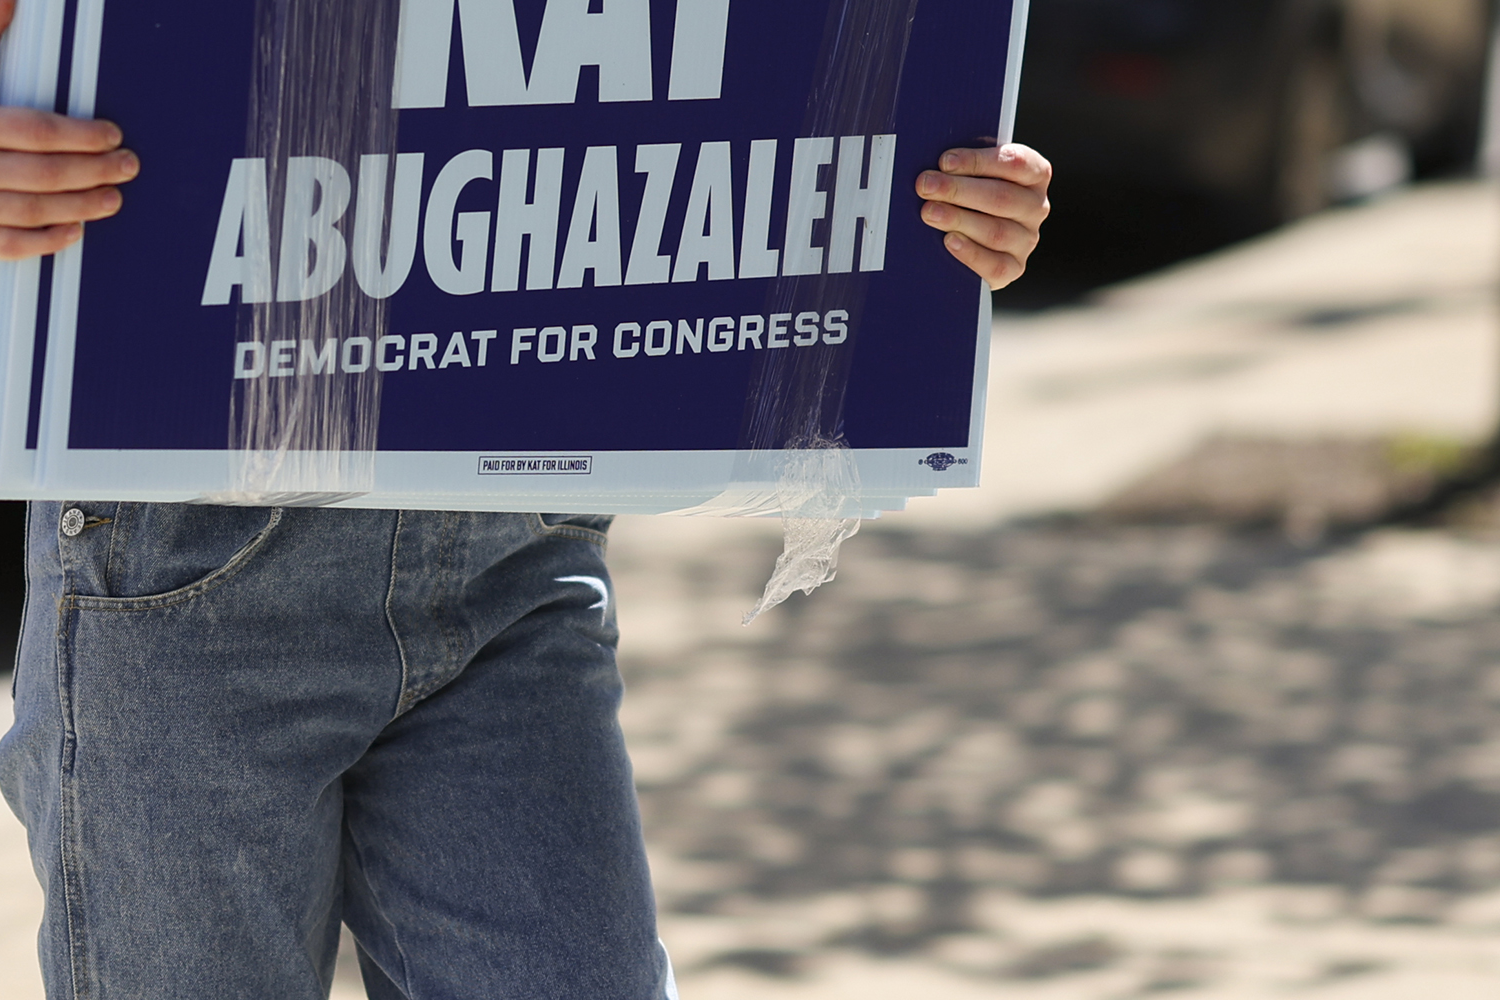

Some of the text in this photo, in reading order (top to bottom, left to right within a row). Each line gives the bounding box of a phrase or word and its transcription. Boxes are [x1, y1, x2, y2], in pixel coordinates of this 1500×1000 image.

[201, 133, 897, 306] ABUGHAZALEH
[233, 309, 850, 380] DEMOCRAT FOR CONGRESS
[483, 460, 588, 471] PAID FOR BY KAT FOR ILLINOIS
